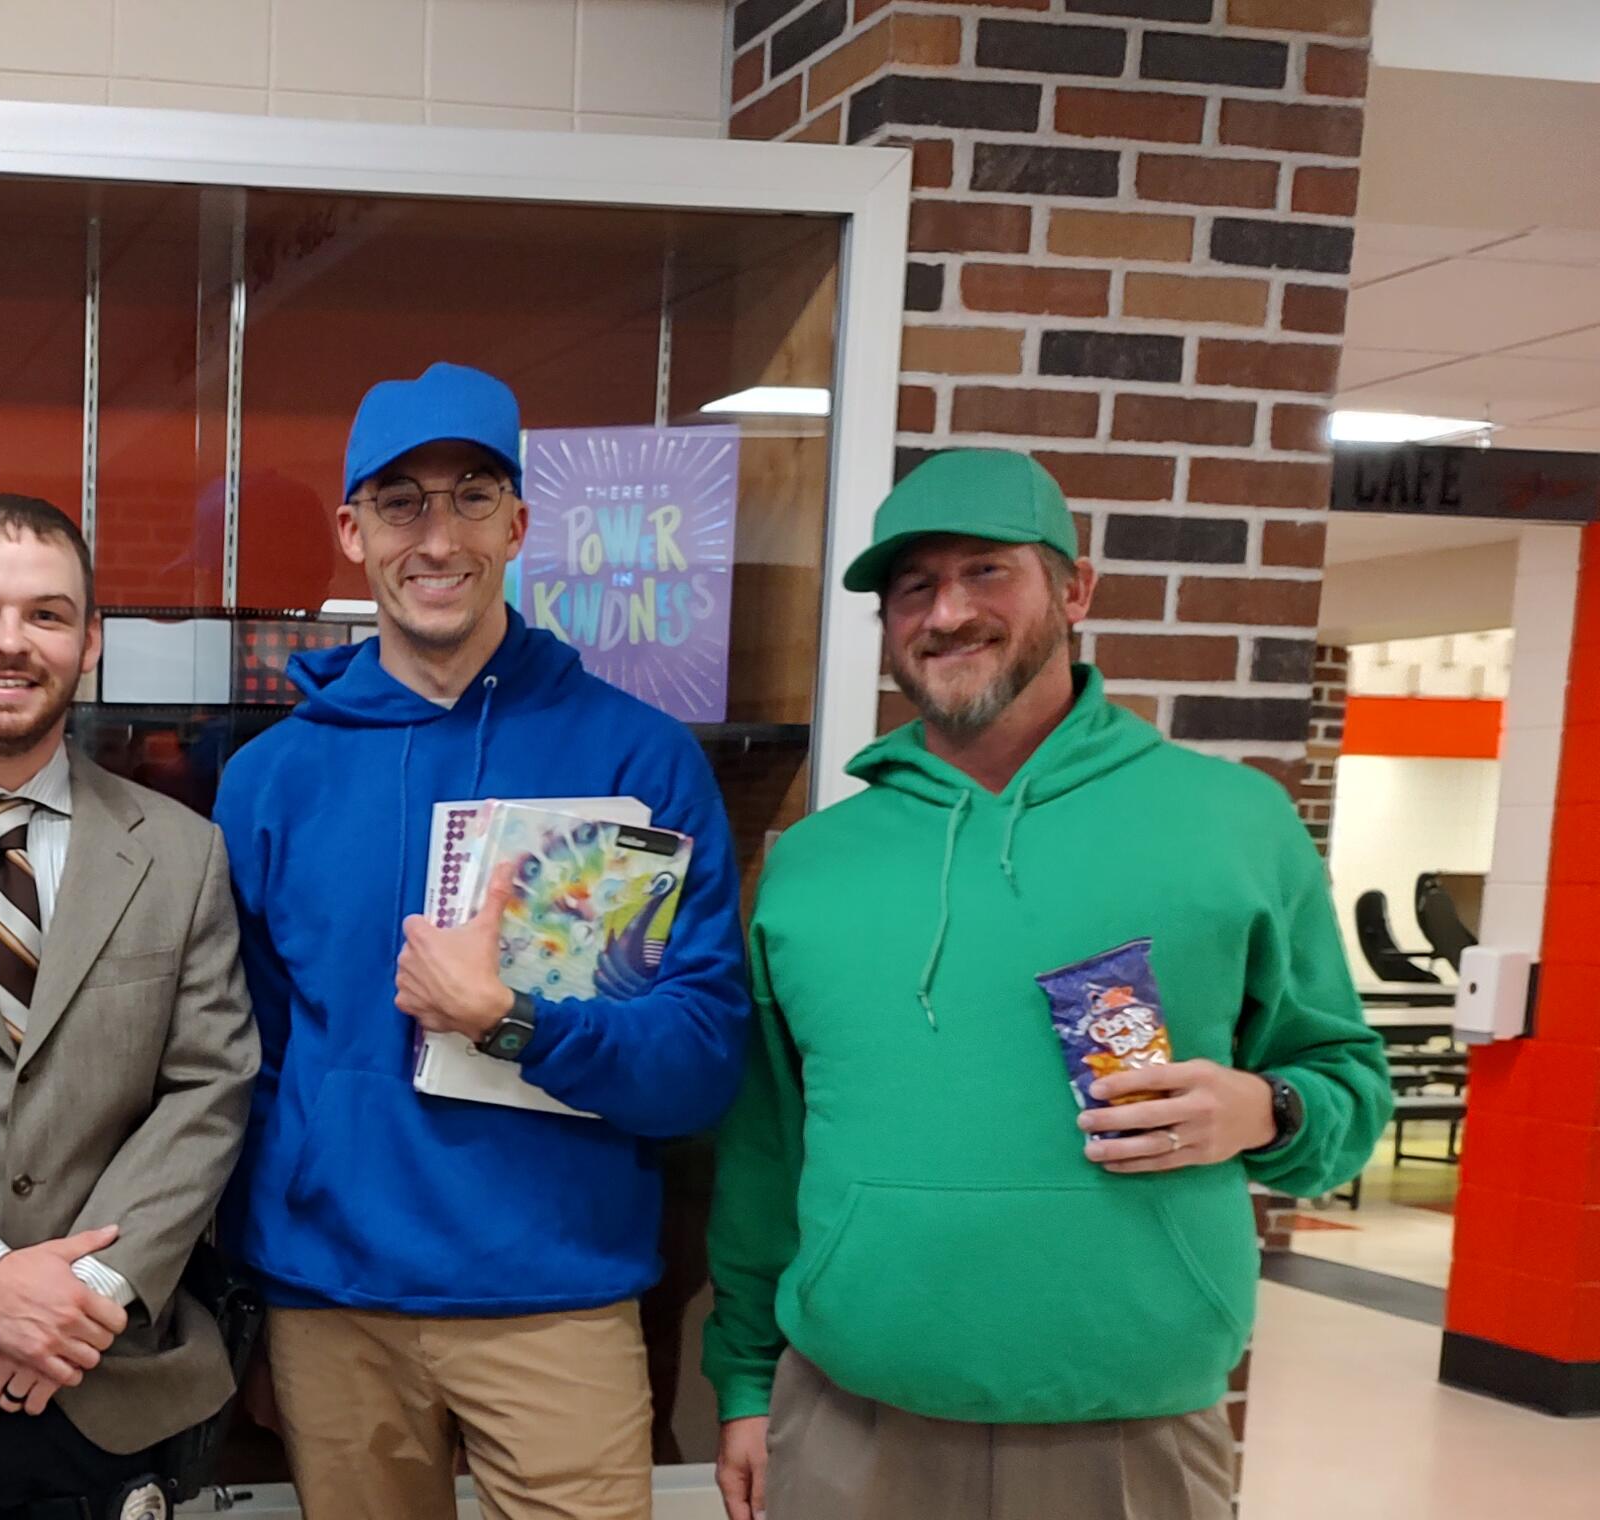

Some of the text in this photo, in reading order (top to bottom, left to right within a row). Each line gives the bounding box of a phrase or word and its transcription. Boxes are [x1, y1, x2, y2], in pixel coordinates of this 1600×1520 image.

[584, 483, 671, 501] THERE IS
[561, 504, 689, 576] POWER
[612, 571, 635, 587] IN
[533, 573, 715, 651] KINDNESS
